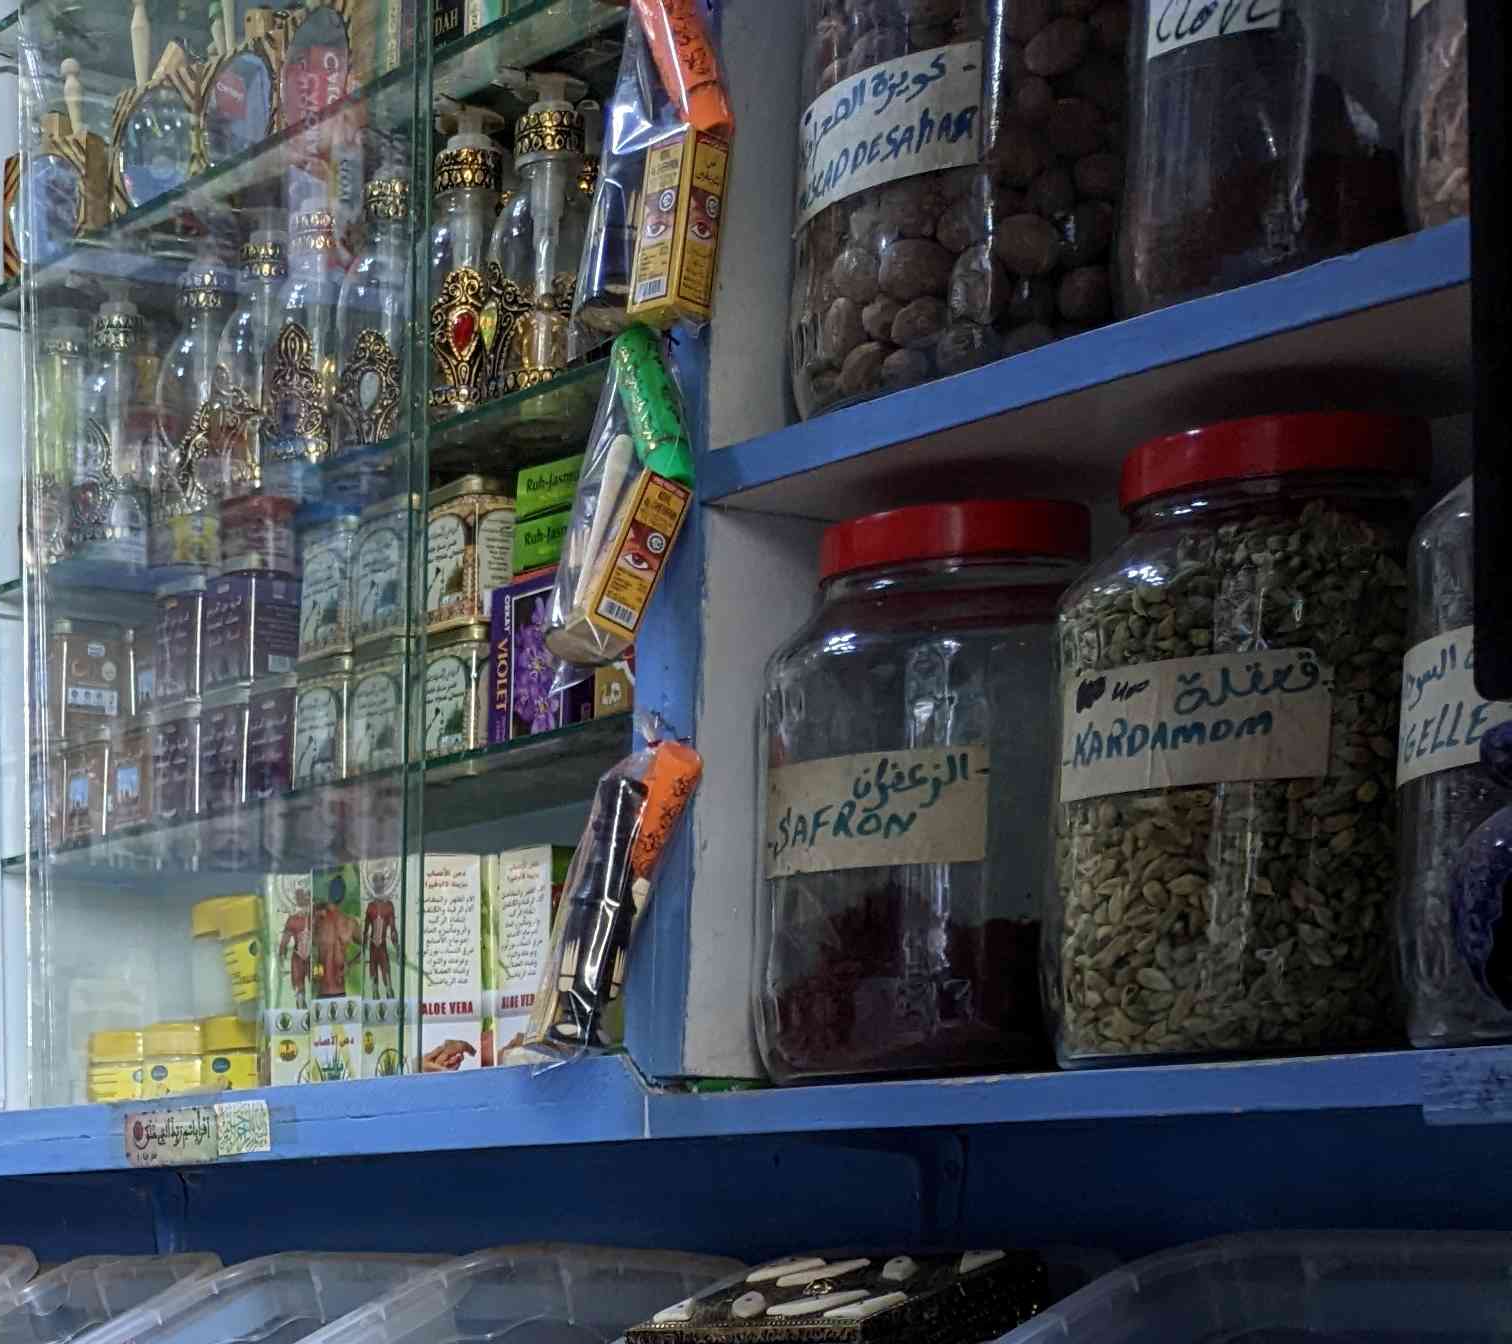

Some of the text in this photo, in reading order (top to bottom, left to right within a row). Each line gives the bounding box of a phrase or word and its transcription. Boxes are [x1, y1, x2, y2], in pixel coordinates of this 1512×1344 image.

[495, 639, 512, 713] VIOLET
[422, 1001, 473, 1015] ALOE VERA
